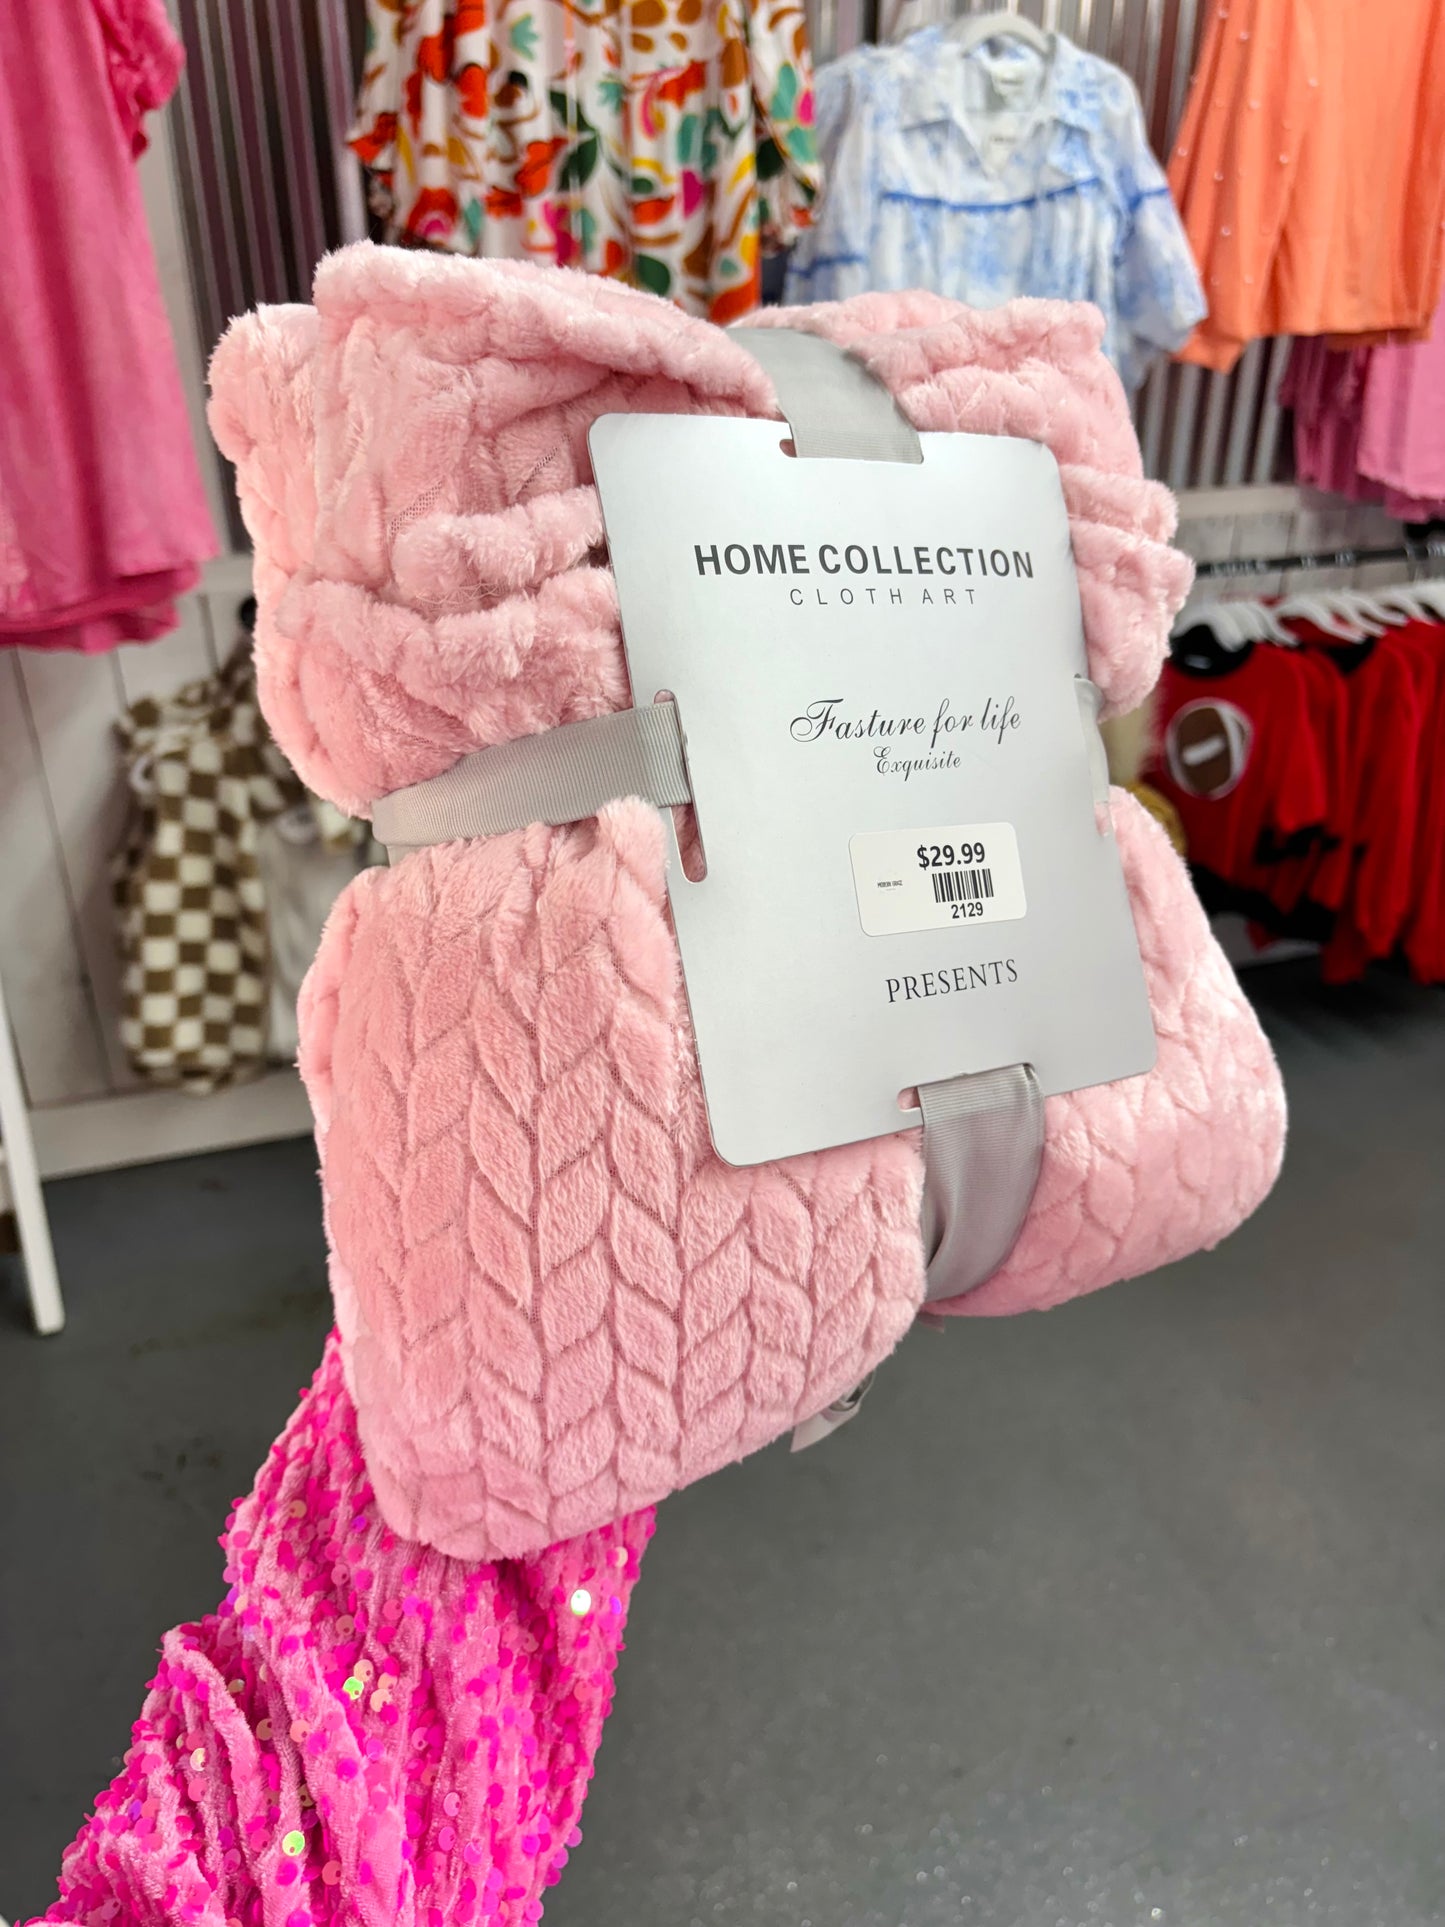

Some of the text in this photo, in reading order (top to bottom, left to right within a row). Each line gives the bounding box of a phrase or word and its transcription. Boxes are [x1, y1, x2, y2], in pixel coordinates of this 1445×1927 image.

[694, 544, 1034, 578] HOME COLLECTION
[790, 588, 975, 605] CLOTH ART
[789, 696, 1021, 748] Fasture for life
[873, 746, 961, 781] Exquisite
[917, 843, 986, 870] $29.99
[951, 902, 984, 919] 2129
[885, 959, 1018, 1003] PRESENTS
